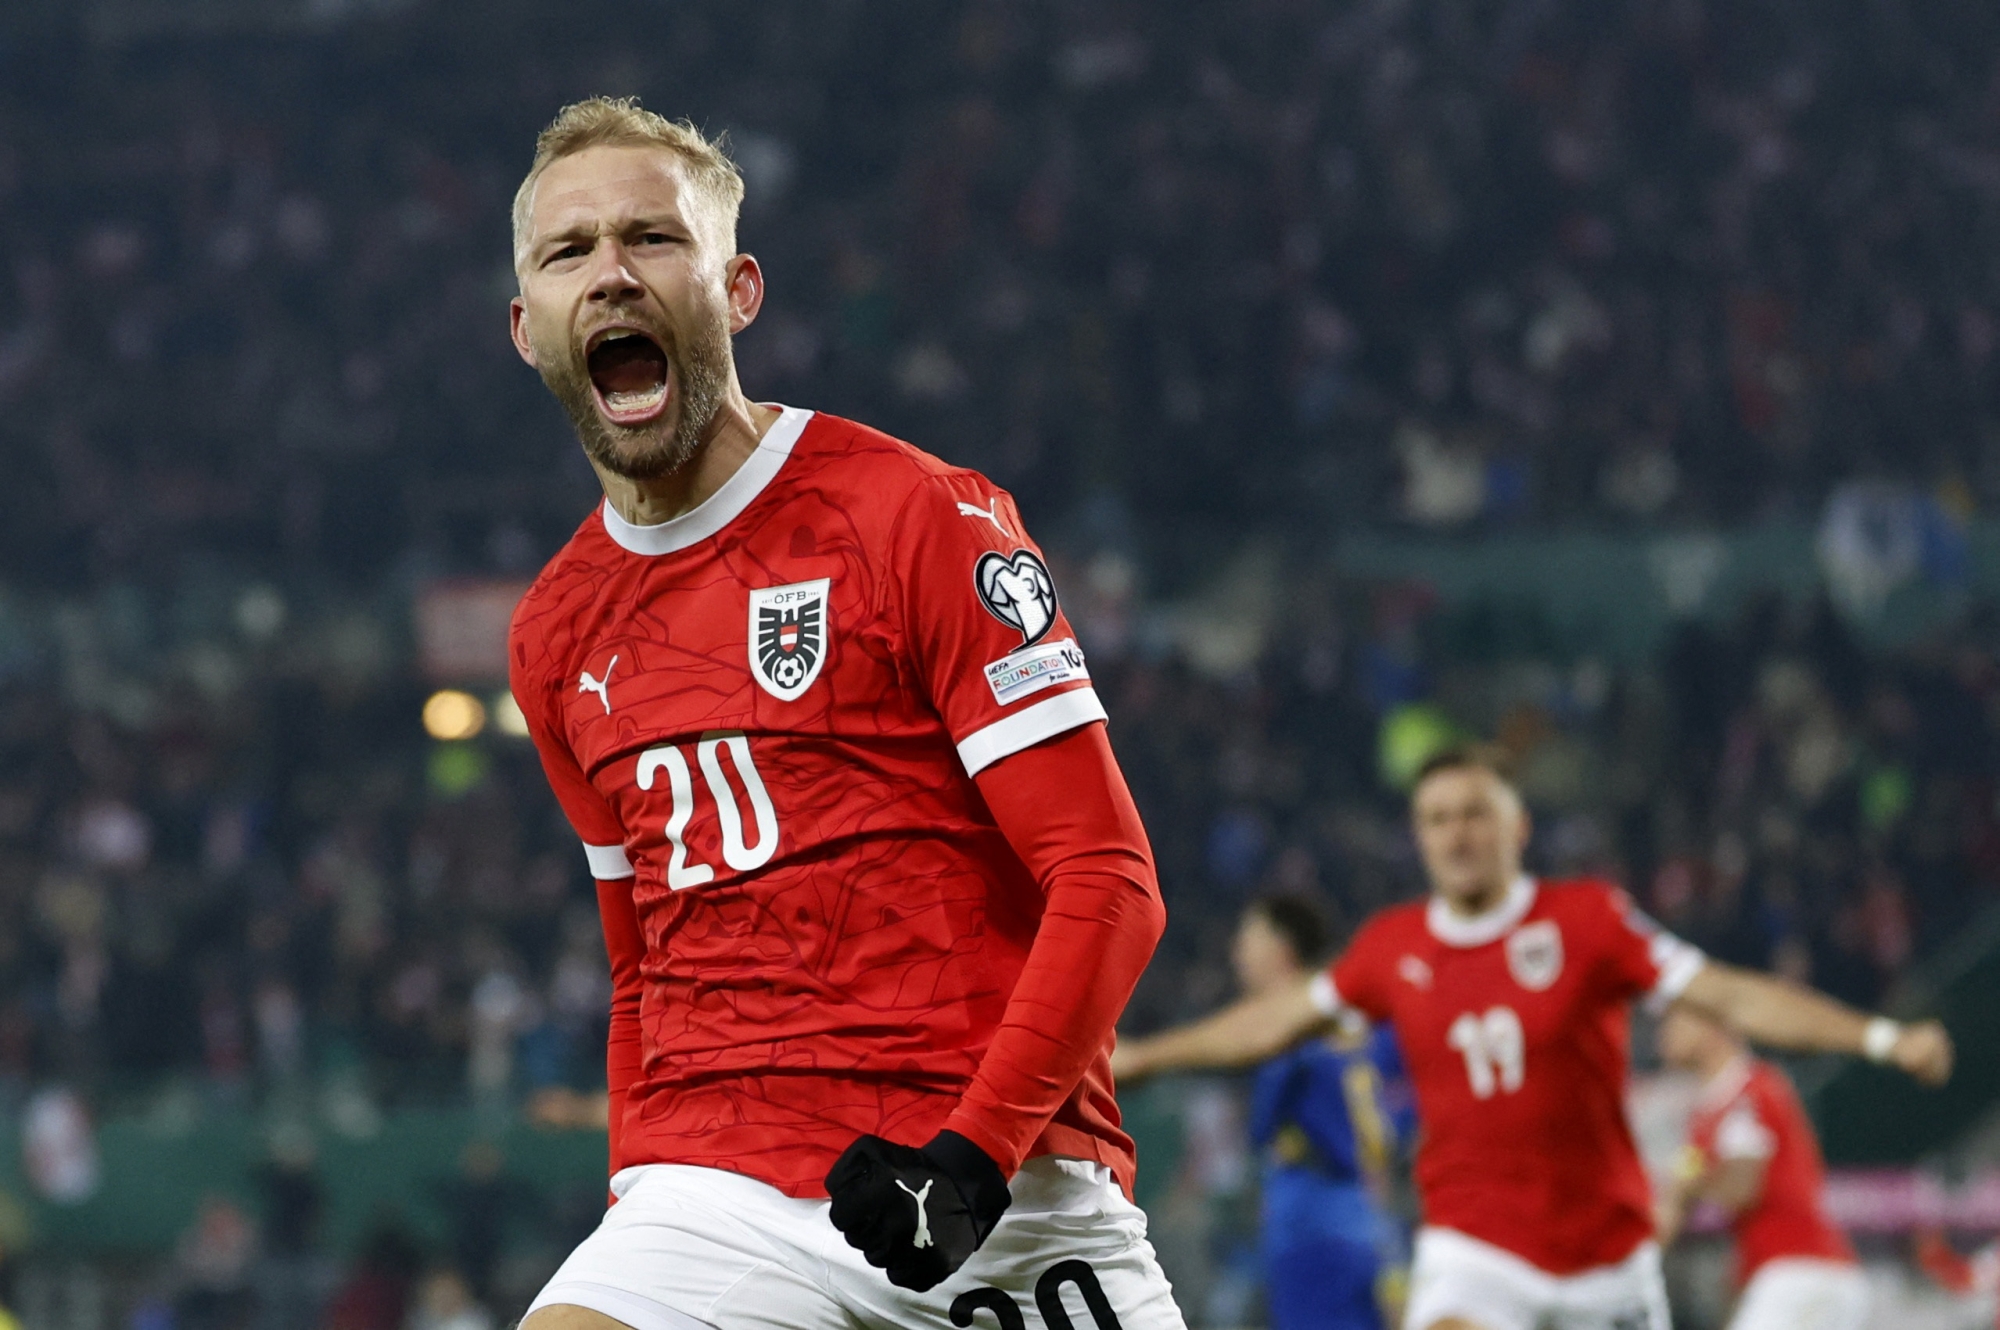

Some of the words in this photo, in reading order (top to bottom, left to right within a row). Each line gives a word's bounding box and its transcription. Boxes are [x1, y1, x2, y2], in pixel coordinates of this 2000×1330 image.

[774, 591, 807, 604] ÖFB
[988, 662, 1010, 676] UEFA
[993, 658, 1065, 690] FOUNDATION
[636, 730, 779, 891] 20
[1447, 1005, 1526, 1100] 19
